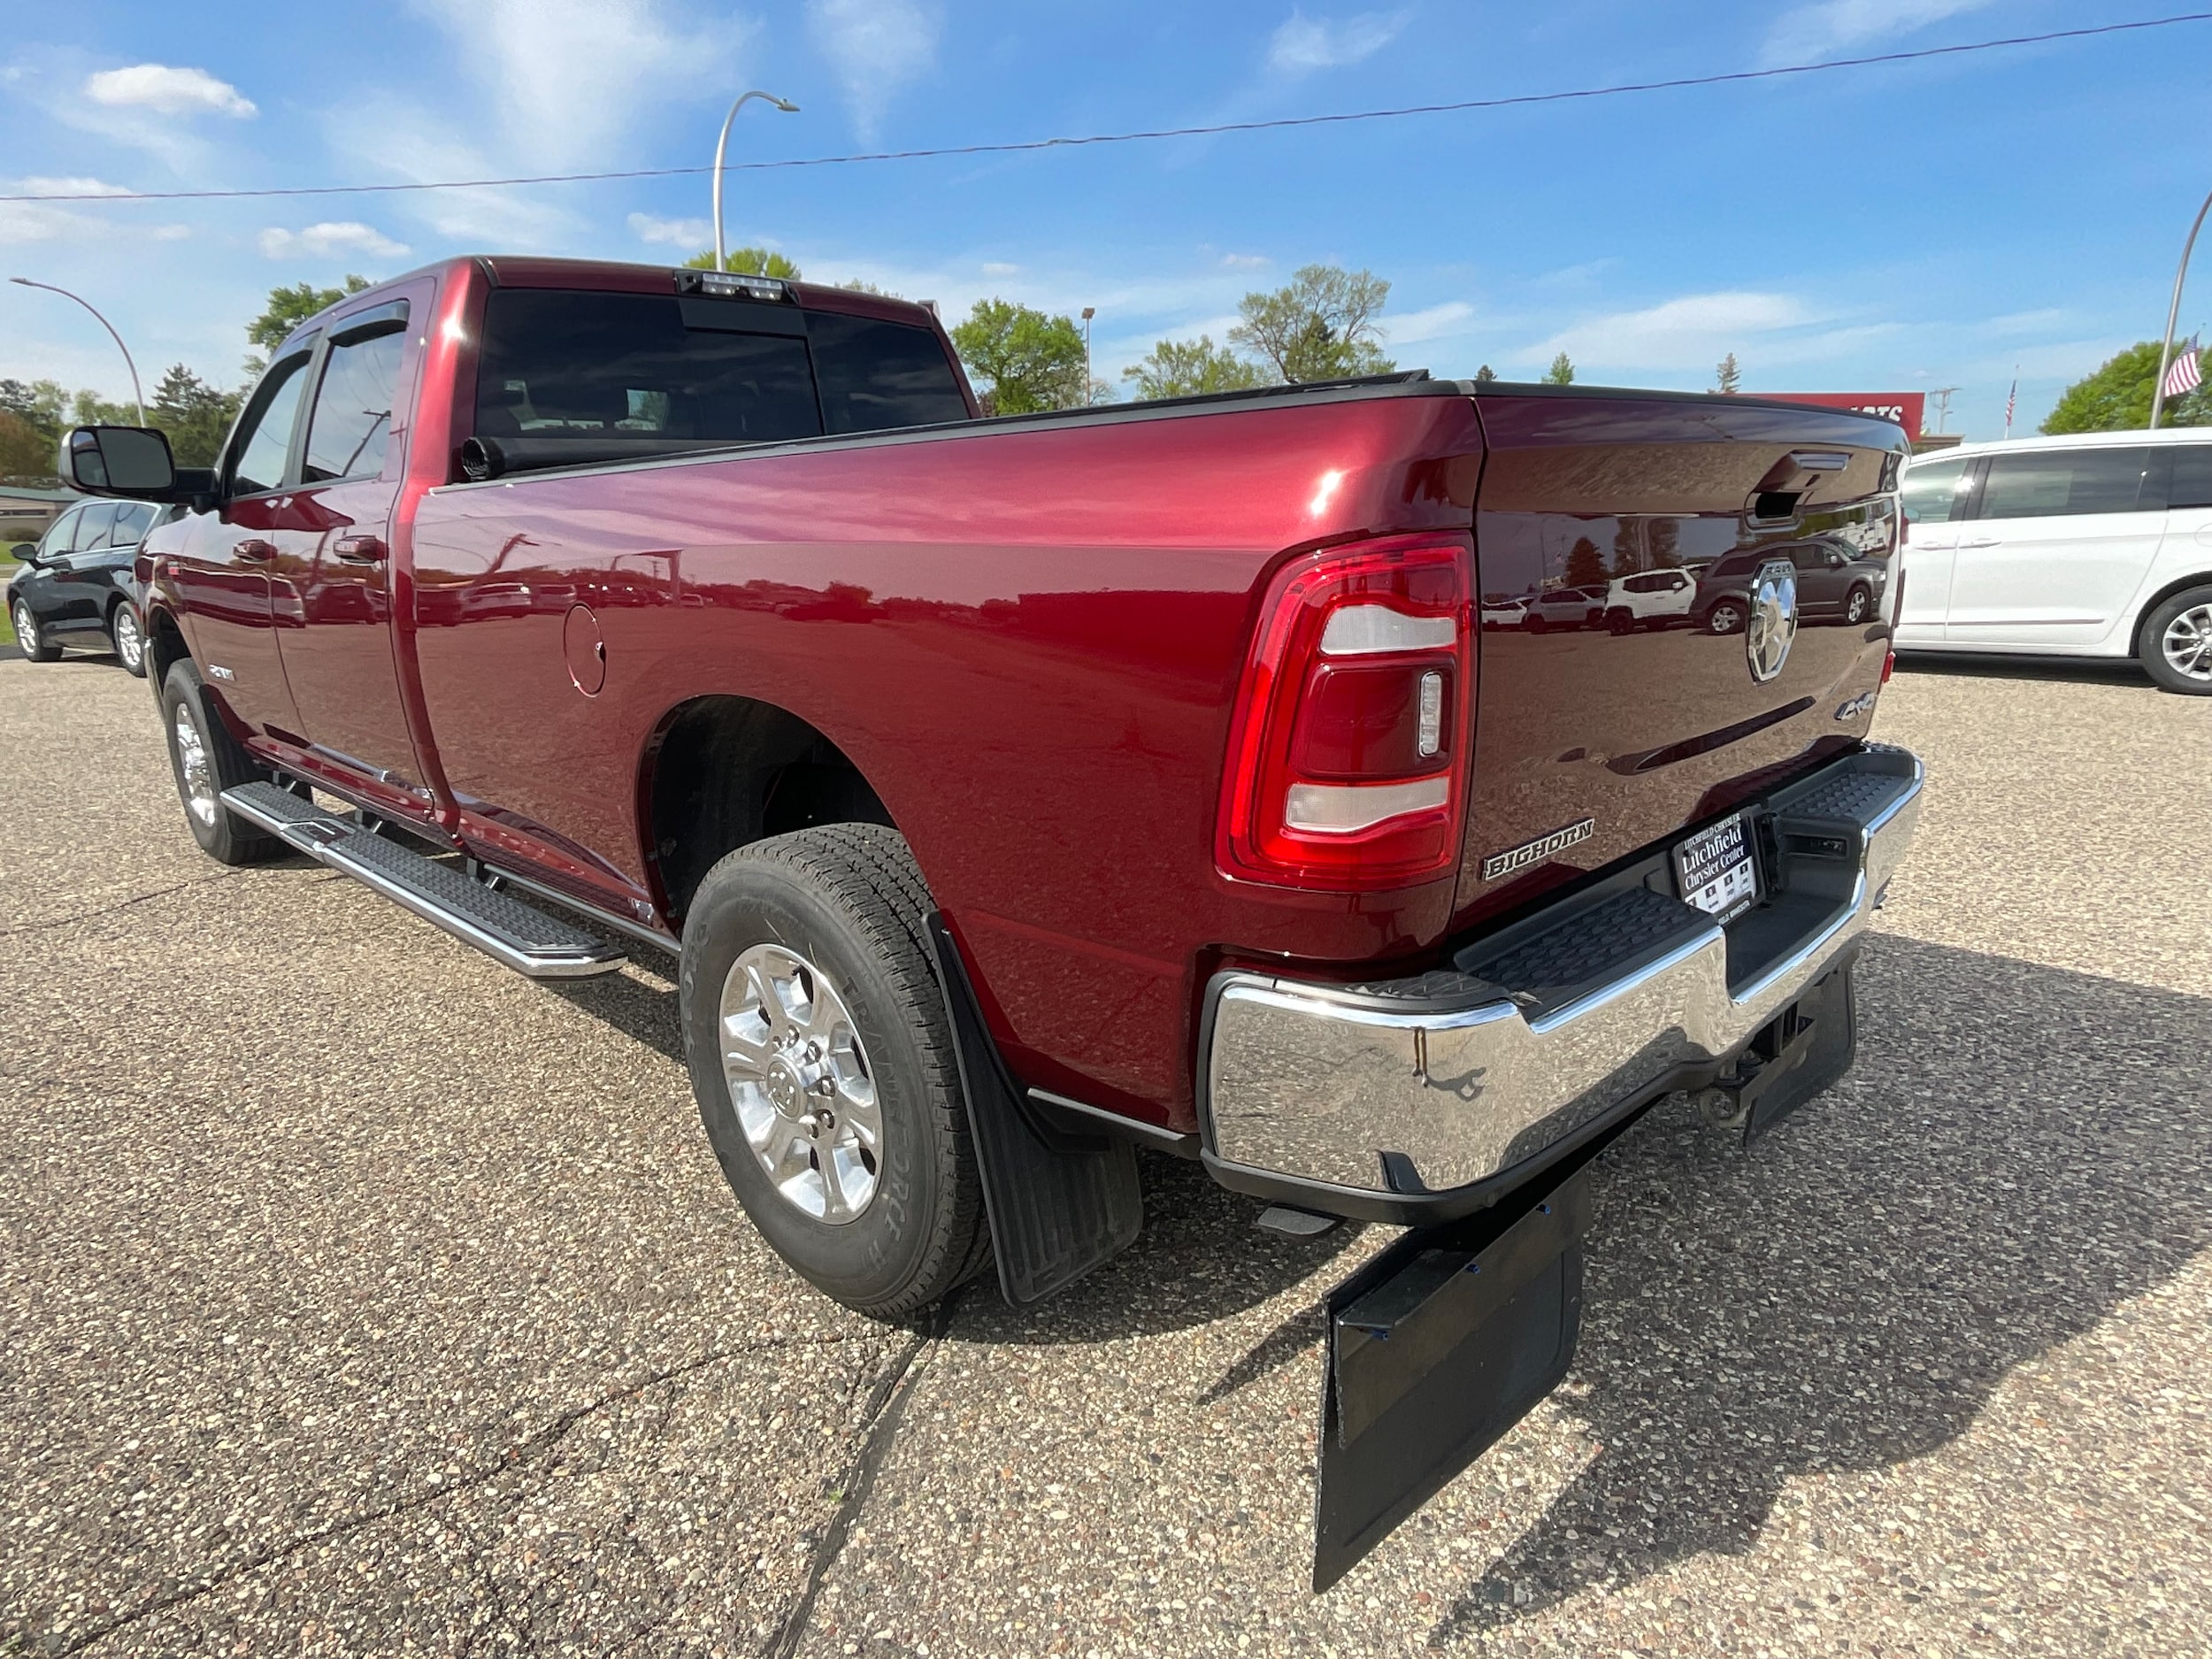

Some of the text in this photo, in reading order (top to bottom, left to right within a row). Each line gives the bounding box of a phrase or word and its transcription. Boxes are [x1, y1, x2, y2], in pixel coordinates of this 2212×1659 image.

[1849, 404, 1903, 422] TS
[1682, 822, 1743, 875] Litchfield
[1684, 845, 1745, 891] Chrysler Center
